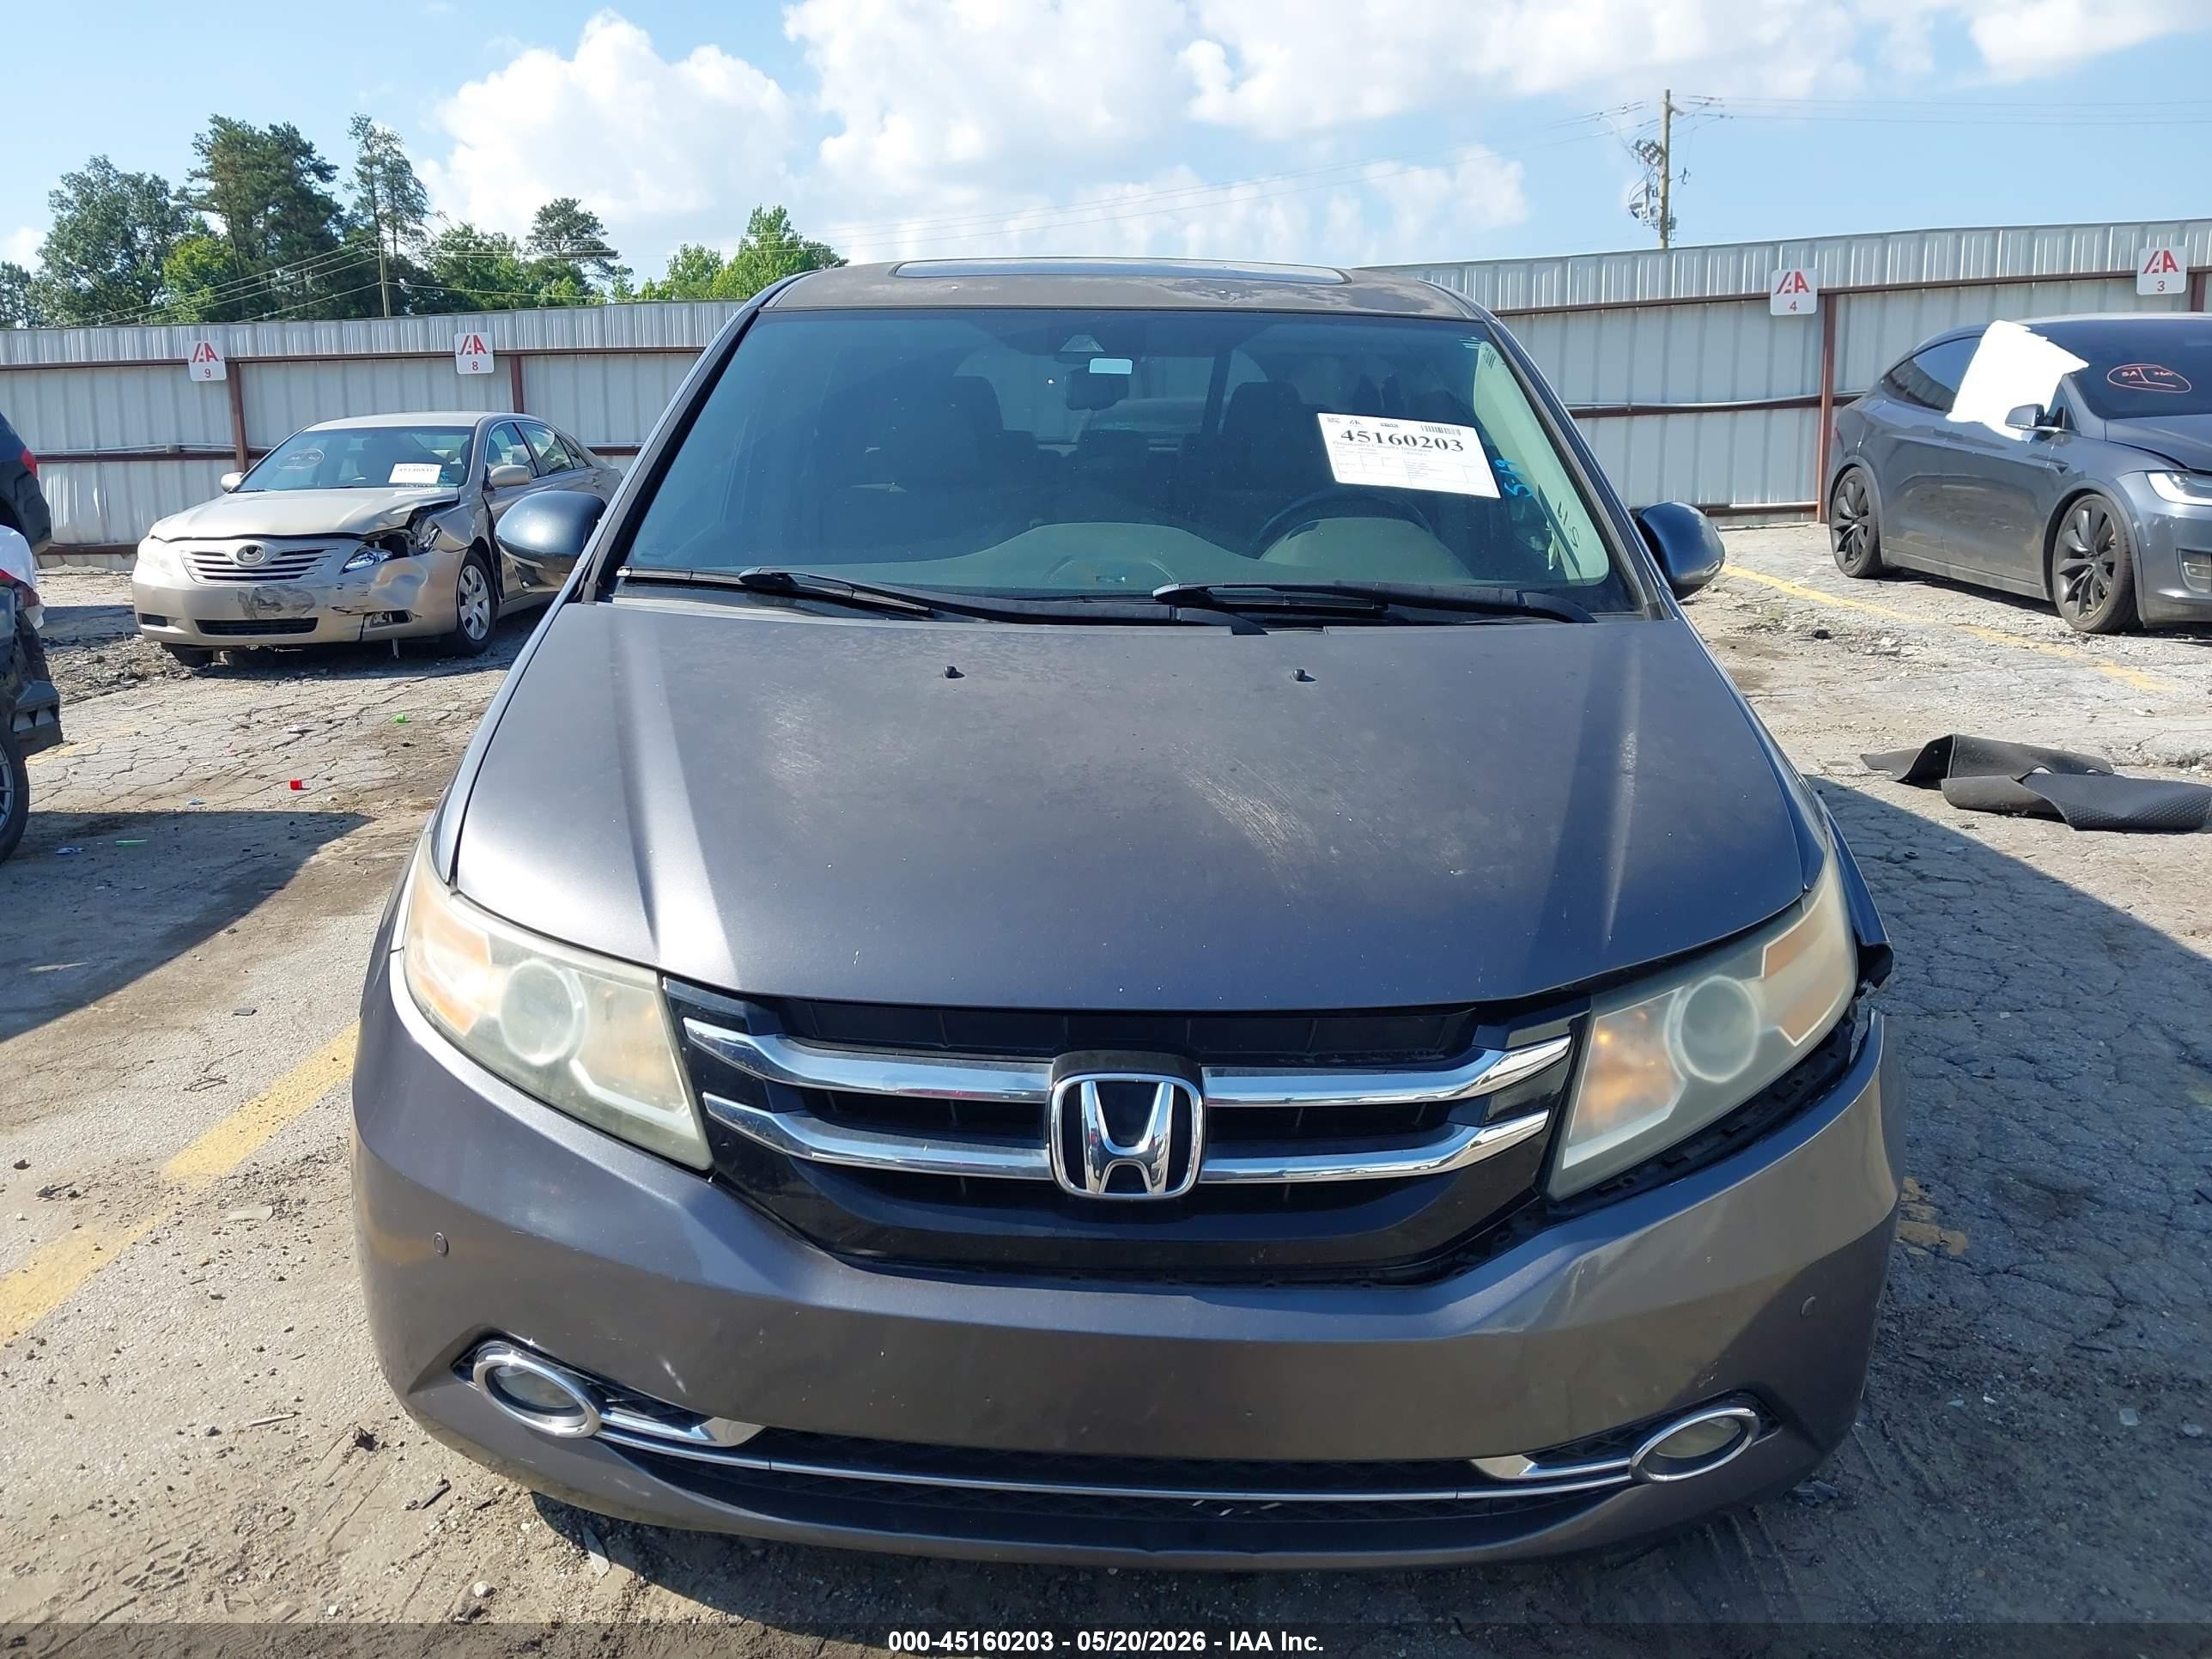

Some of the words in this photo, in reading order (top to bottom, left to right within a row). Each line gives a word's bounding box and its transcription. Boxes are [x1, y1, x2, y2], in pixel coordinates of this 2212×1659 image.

[2157, 280, 2165, 292] 3
[1789, 301, 1797, 312] 4
[472, 361, 478, 371] 8
[204, 368, 211, 378] 9
[1340, 429, 1464, 453] 45160203
